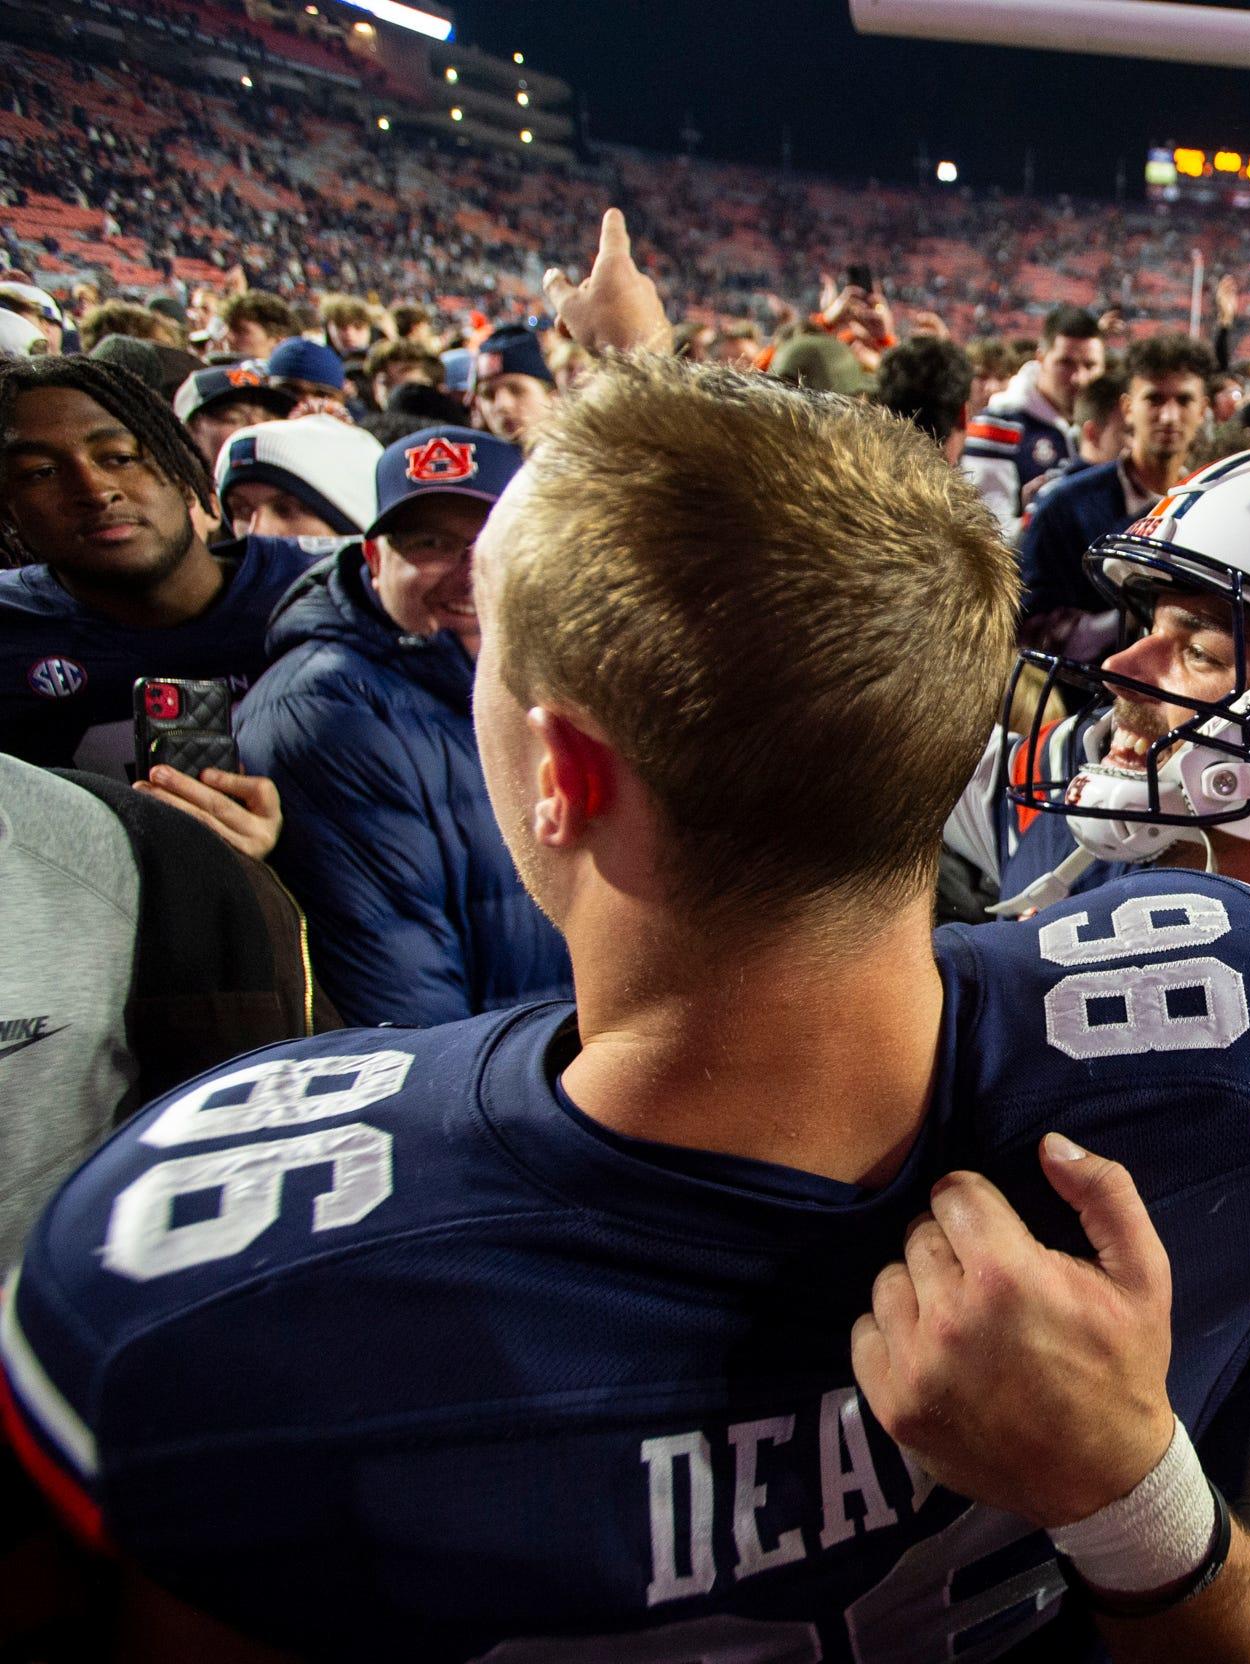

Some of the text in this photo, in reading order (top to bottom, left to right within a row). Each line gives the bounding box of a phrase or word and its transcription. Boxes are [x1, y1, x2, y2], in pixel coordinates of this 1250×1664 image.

[31, 658, 83, 697] SEC
[1038, 893, 1250, 1061] 86
[101, 1049, 416, 1283] 86
